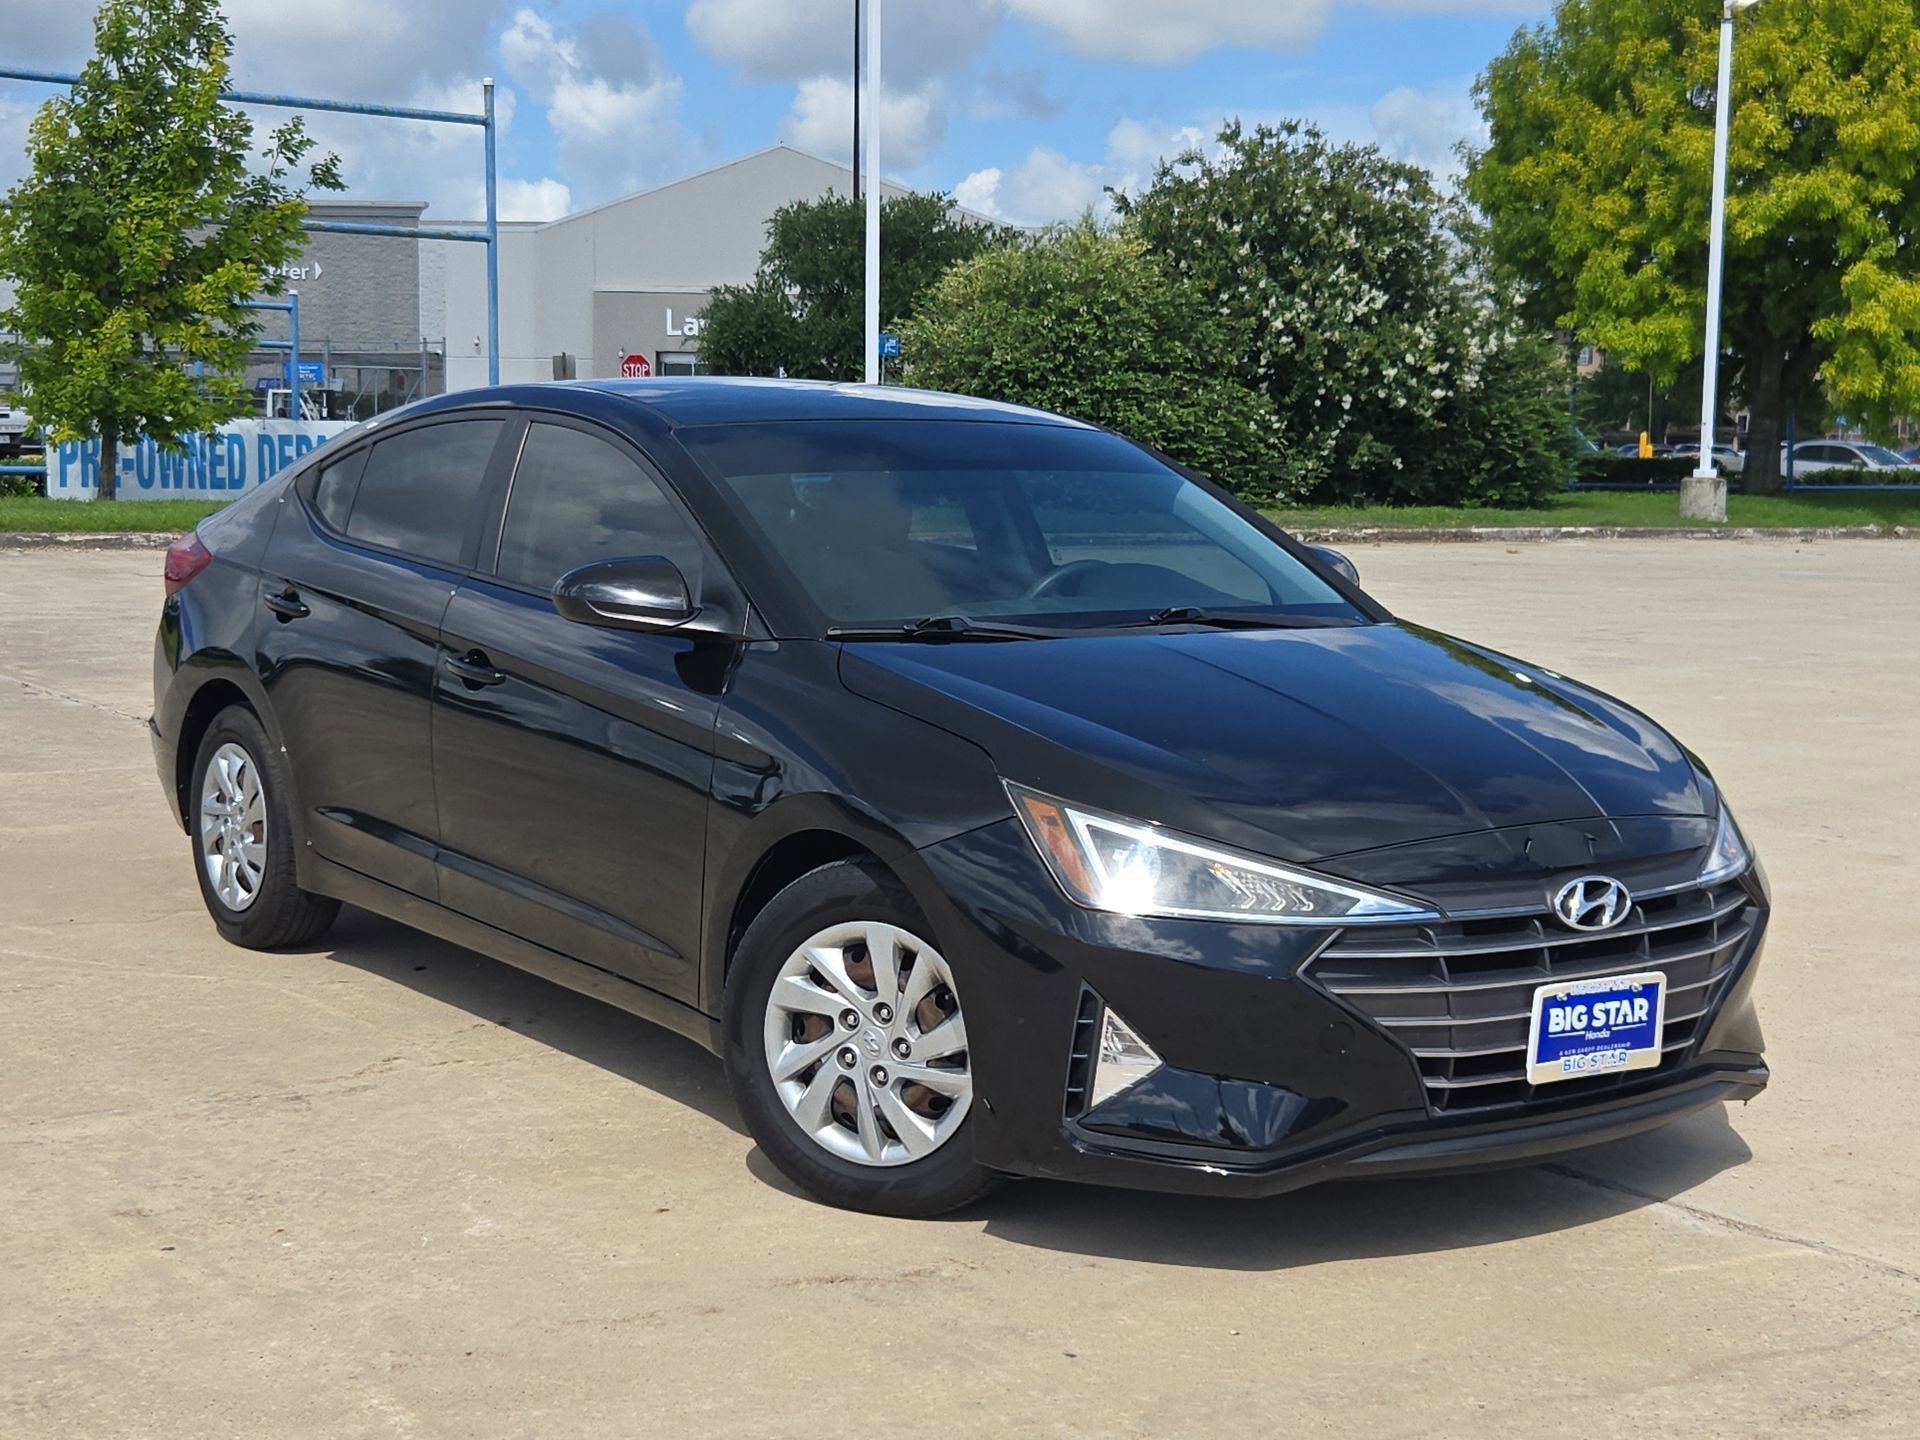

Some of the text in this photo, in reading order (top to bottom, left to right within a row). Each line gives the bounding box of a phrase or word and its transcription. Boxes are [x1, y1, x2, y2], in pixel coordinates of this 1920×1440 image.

[623, 363, 649, 377] STOP
[1548, 998, 1649, 1033] BIG STAR
[1585, 1028, 1610, 1040] Honda
[1563, 1051, 1628, 1071] BIG STAR
